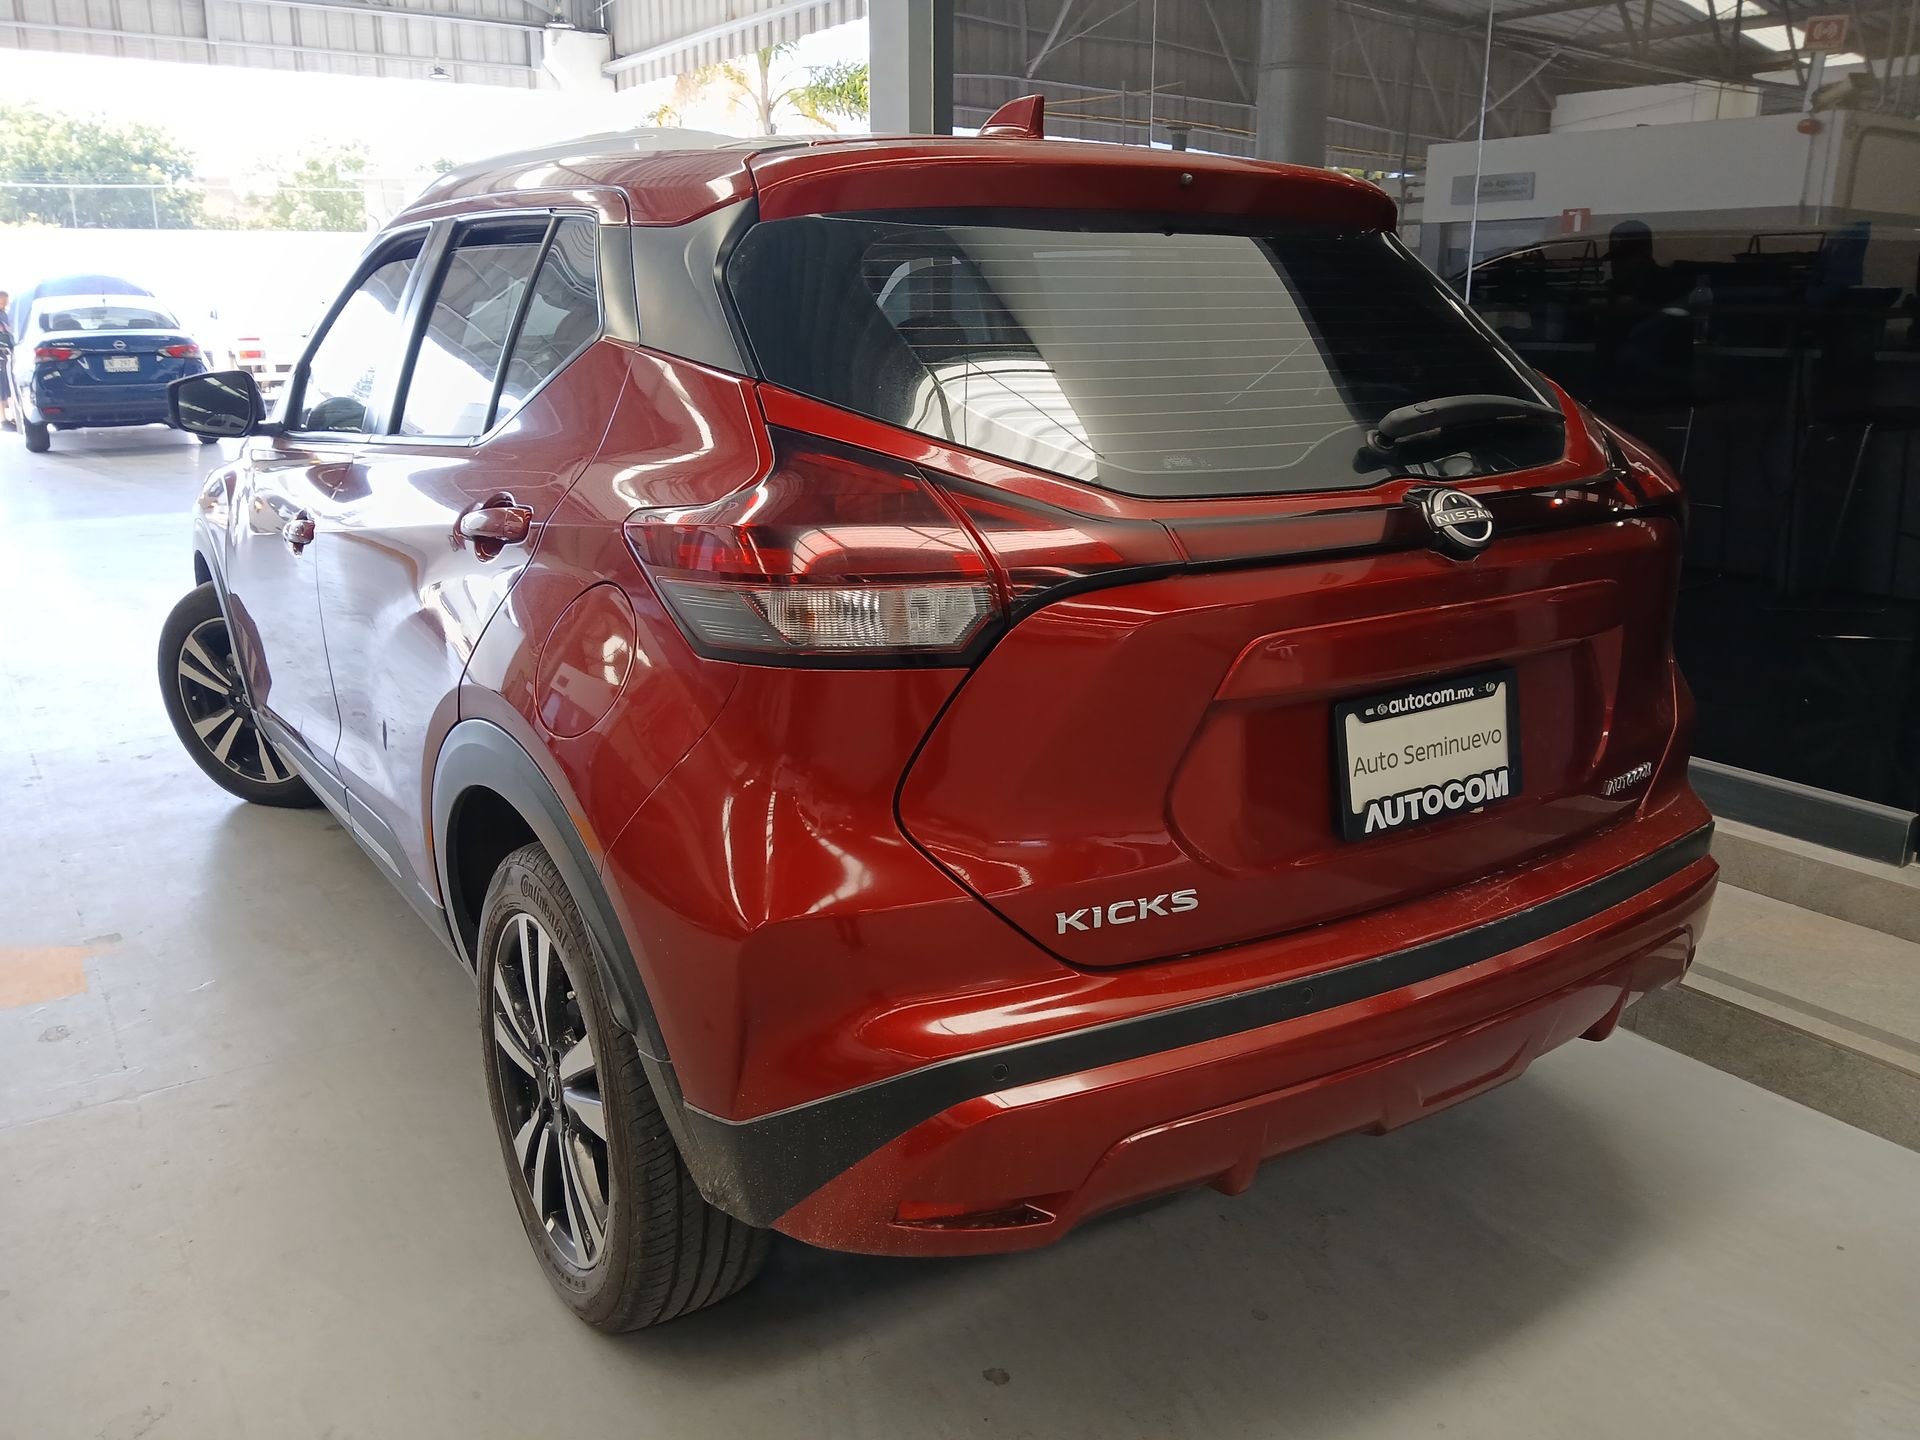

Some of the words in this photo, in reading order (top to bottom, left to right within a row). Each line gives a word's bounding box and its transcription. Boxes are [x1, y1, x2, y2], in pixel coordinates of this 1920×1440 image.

[1435, 508, 1494, 524] NISSAN
[1388, 687, 1475, 714] autocom.mx
[1353, 751, 1399, 778] Auto
[1403, 728, 1502, 765] Seminuevo
[1364, 769, 1509, 834] AUTOCOM
[519, 873, 569, 949] Continental
[1055, 888, 1199, 935] KICKS
